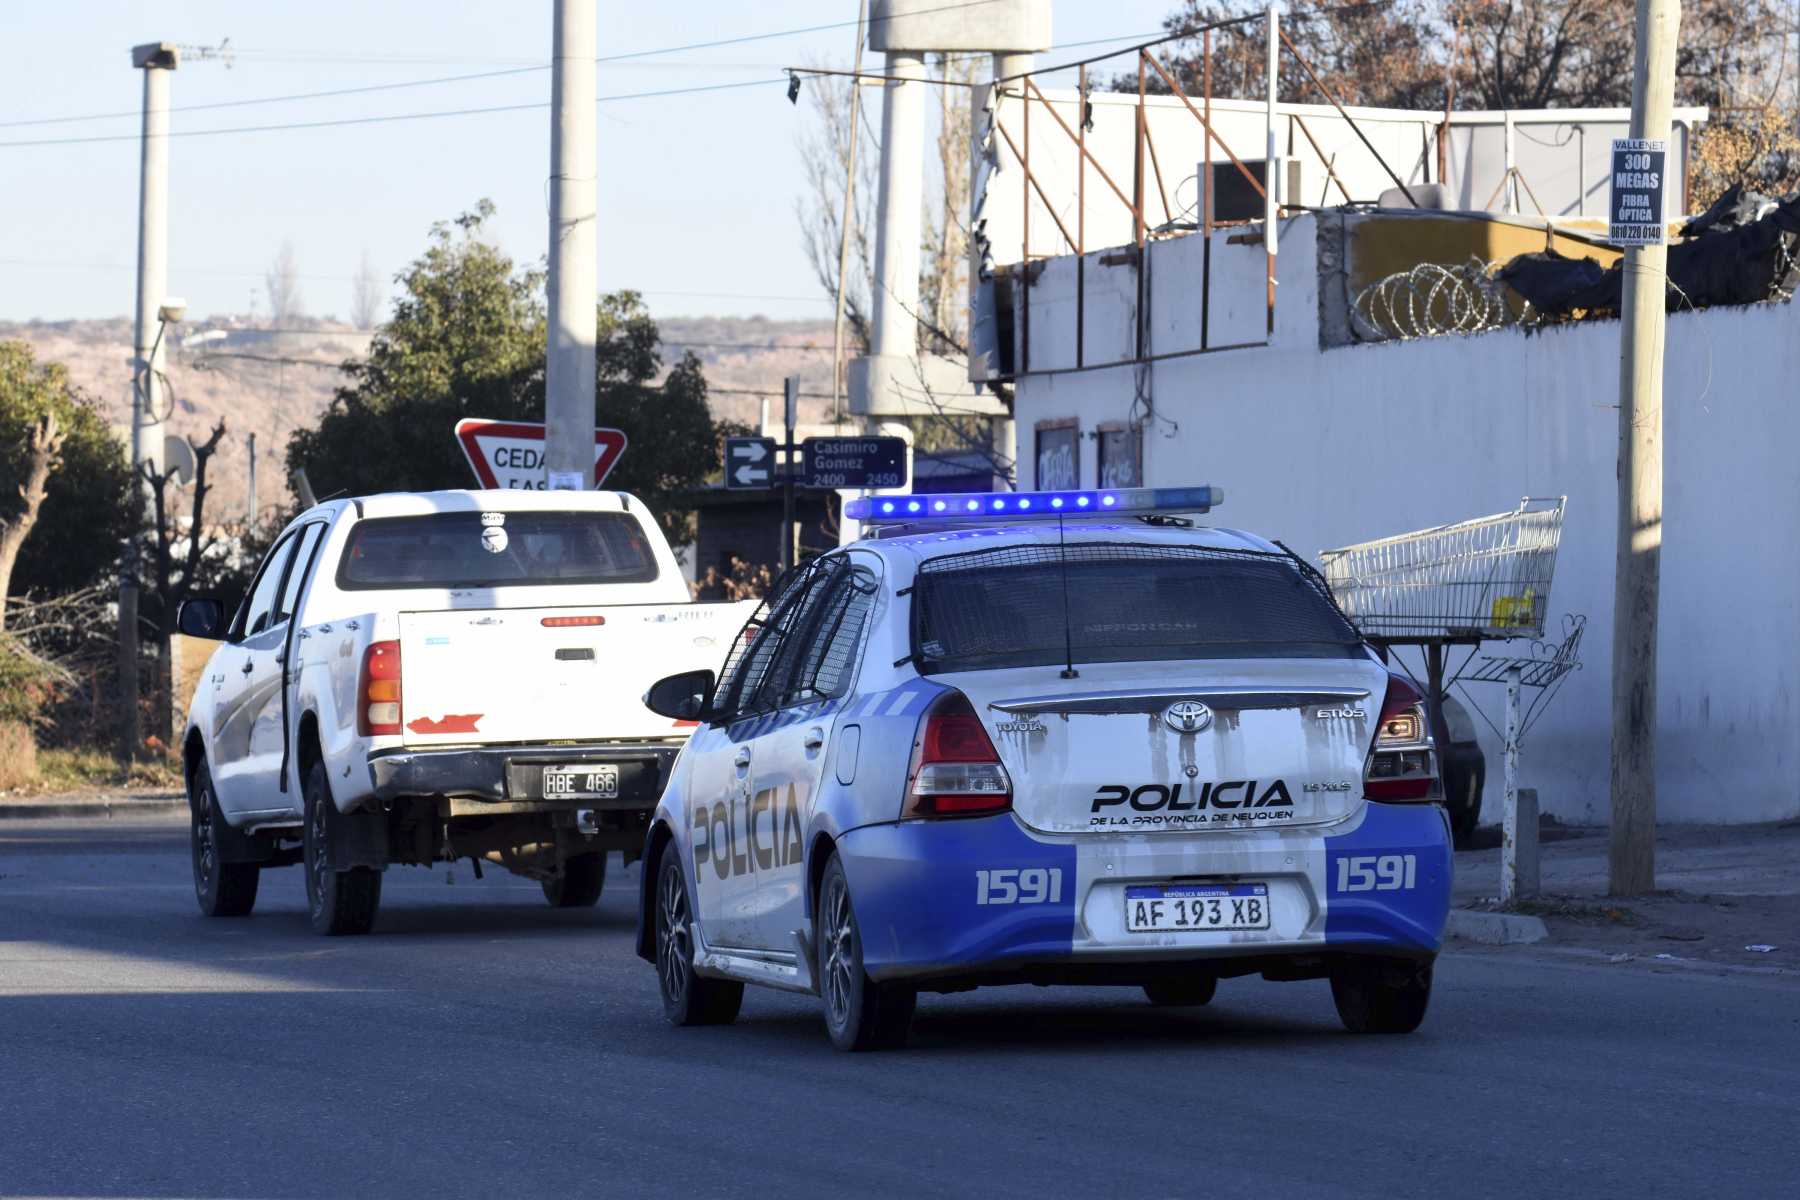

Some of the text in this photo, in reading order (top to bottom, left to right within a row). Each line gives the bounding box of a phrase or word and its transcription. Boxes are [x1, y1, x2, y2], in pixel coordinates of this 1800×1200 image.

[1615, 141, 1664, 150] VALLENET
[1625, 154, 1651, 170] 300
[1616, 172, 1659, 189] MEGAS
[1622, 194, 1650, 207] FIBRA
[814, 441, 878, 454] Casimiro
[814, 455, 864, 470] Gomez
[814, 473, 899, 486] 2400 2450
[1317, 709, 1365, 718] ETIOS
[998, 719, 1042, 732] TOYOTA
[546, 773, 615, 793] HBE 466
[1090, 779, 1294, 813] POLICIA
[1090, 810, 1294, 826] DE LA PROVINCIA DE NEUQUEN
[694, 781, 804, 884] POLICIA
[1336, 854, 1417, 892] 1591
[975, 868, 1062, 905] 1591
[1134, 898, 1262, 927] AF 193 XB
